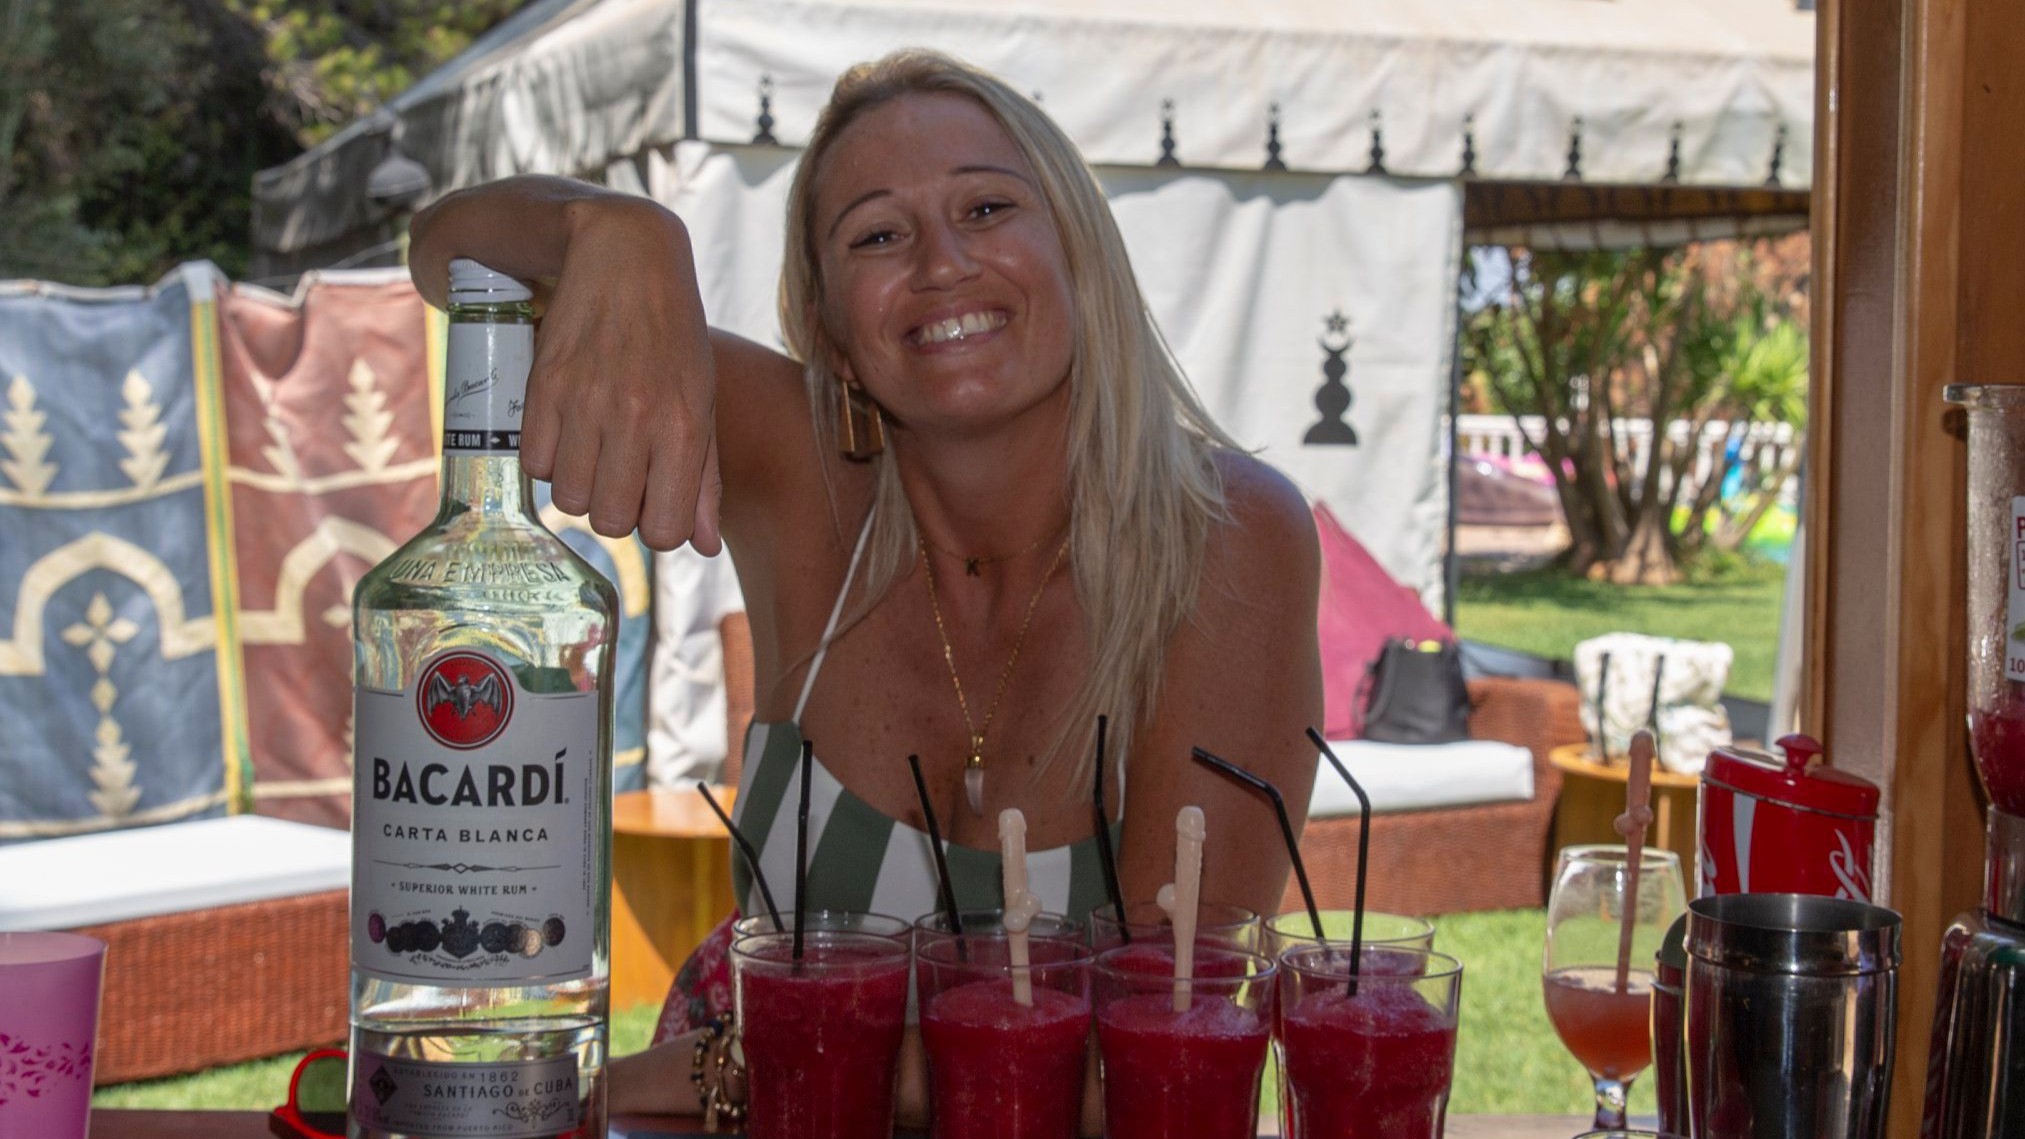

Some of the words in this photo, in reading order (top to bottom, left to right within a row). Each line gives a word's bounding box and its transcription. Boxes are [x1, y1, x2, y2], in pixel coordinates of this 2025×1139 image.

[458, 433, 481, 447] RUM
[390, 559, 437, 582] UNA
[443, 561, 570, 584] EMPRESA
[373, 747, 567, 806] BACARDÍ
[383, 823, 447, 841] CARTA
[459, 828, 548, 842] BLANCA
[399, 882, 454, 895] SUPERIOR
[458, 885, 498, 895] WHITE
[503, 884, 527, 895] RUM
[481, 1071, 519, 1083] 1862
[424, 1084, 514, 1099] SANTIAGO
[519, 1088, 530, 1097] DE
[533, 1077, 573, 1095] CUBA
